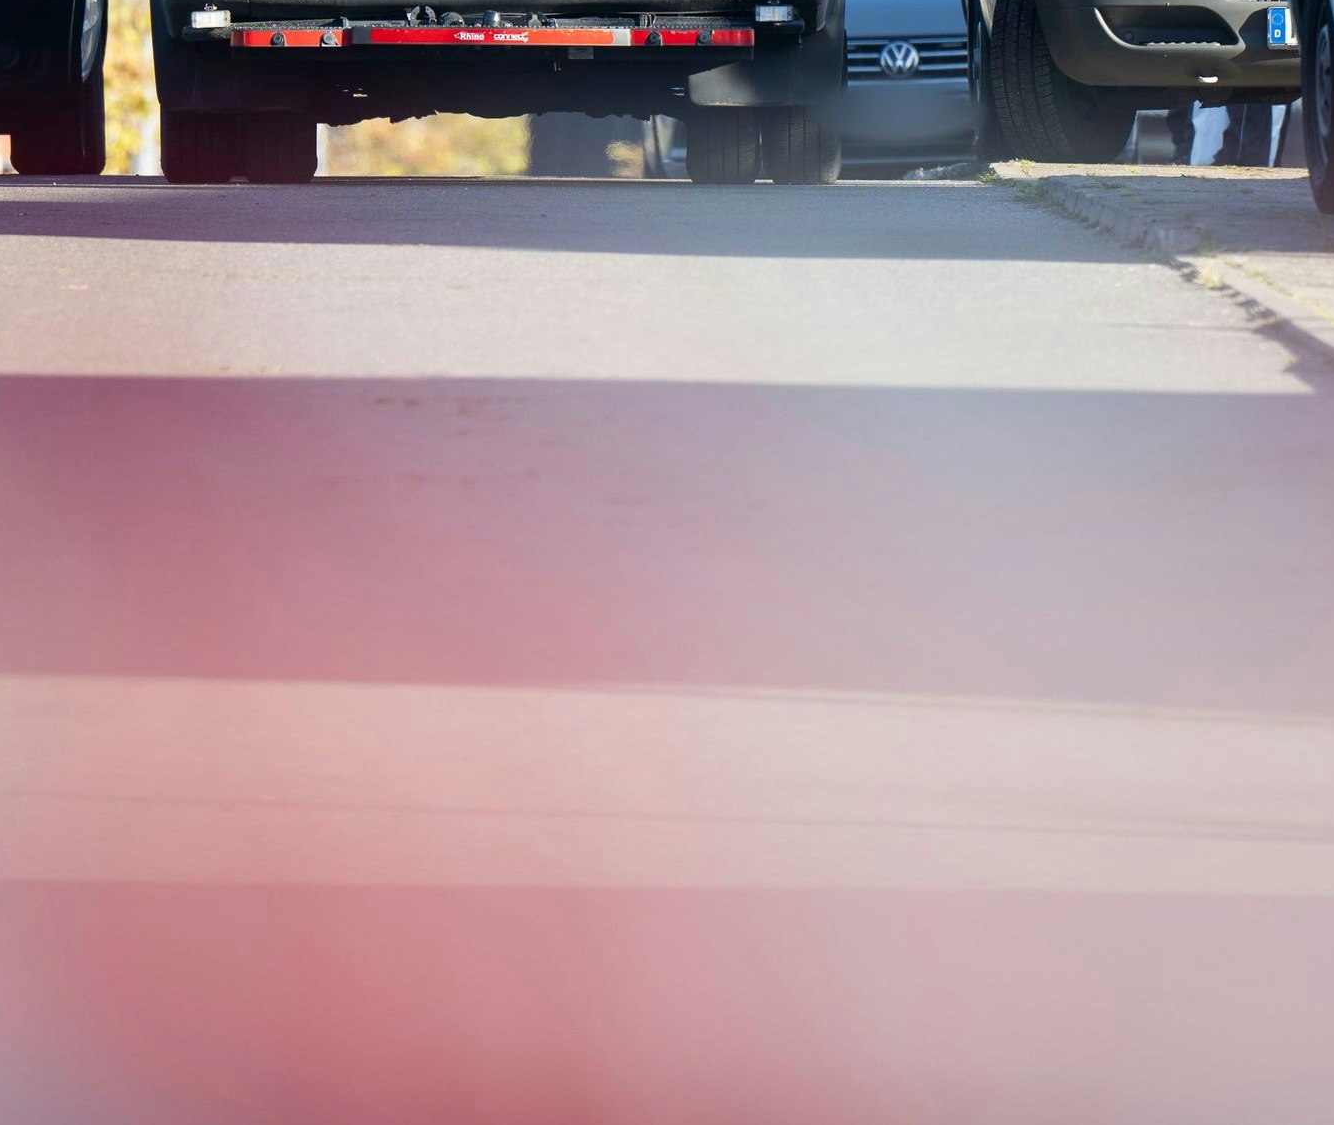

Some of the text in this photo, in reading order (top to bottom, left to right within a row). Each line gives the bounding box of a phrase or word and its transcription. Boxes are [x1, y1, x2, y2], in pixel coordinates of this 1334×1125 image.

[460, 31, 485, 41] Rhino
[1274, 29, 1282, 38] D
[880, 40, 920, 79] VW
